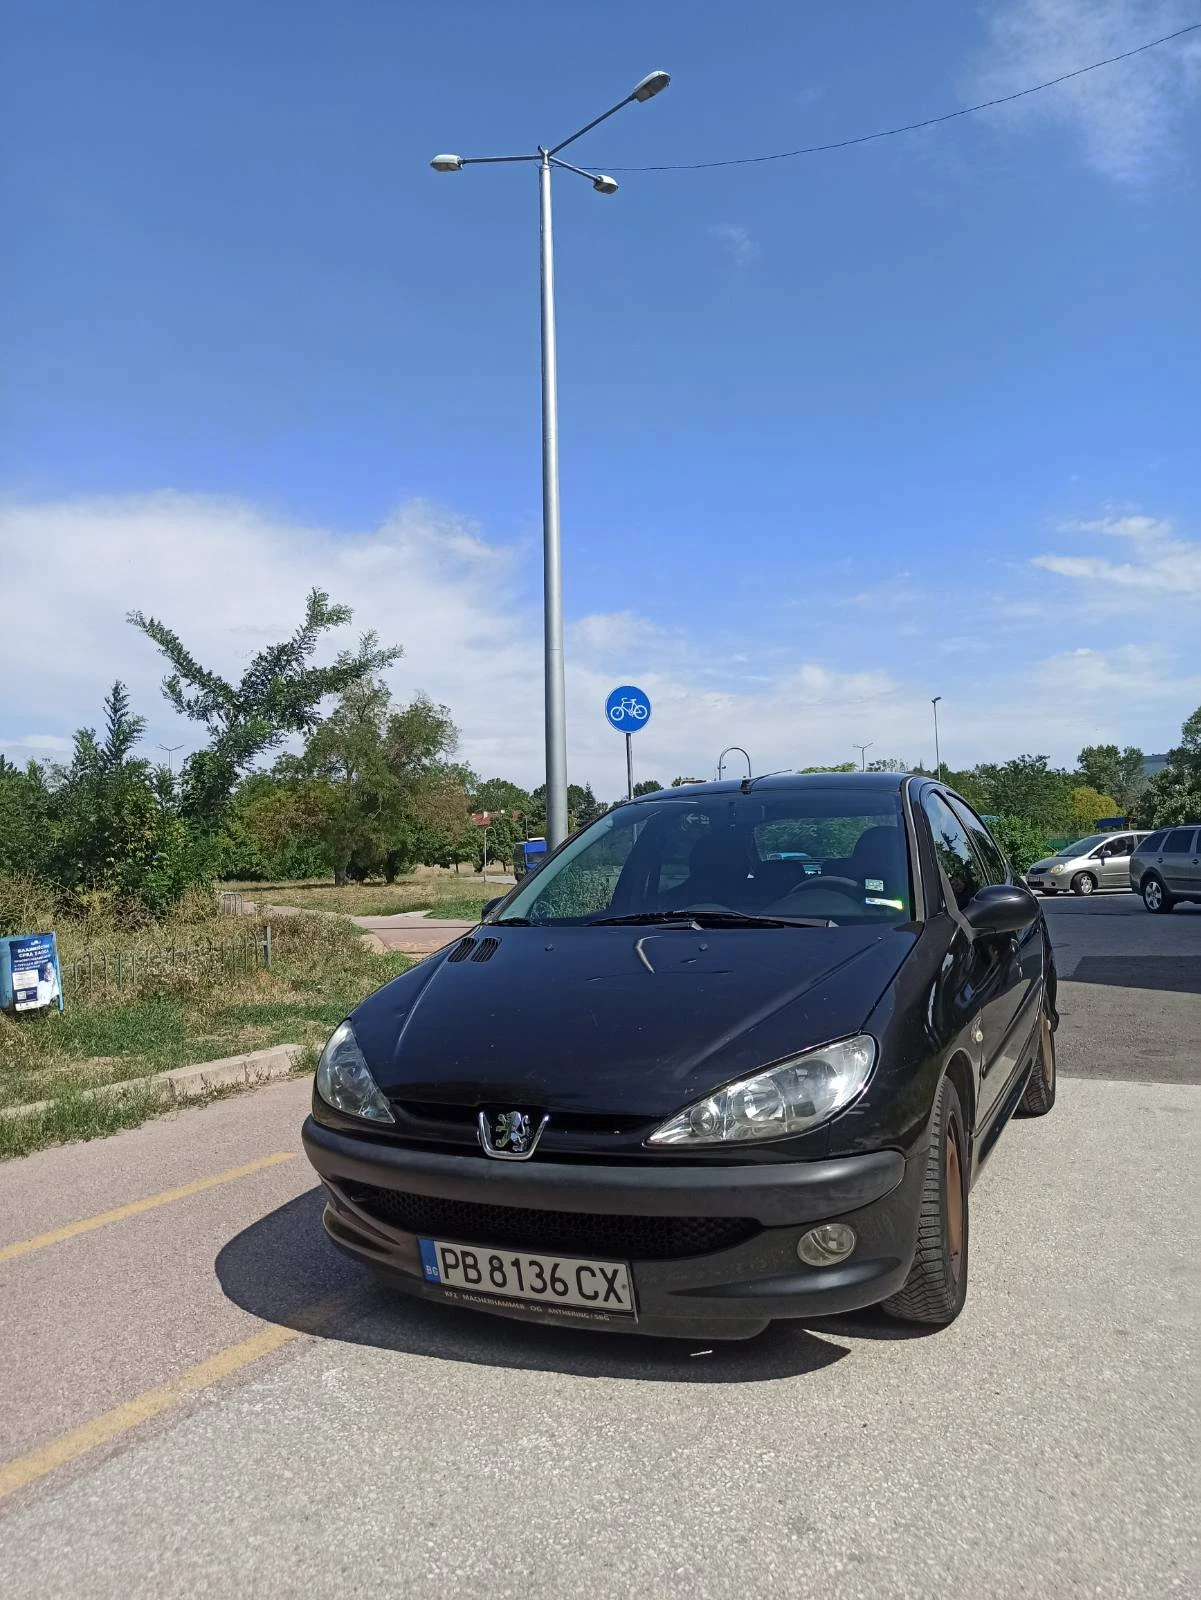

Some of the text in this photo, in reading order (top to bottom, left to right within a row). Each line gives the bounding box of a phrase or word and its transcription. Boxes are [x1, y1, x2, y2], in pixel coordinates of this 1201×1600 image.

[425, 1264, 439, 1277] BG
[440, 1247, 624, 1304] PB 8136 CX
